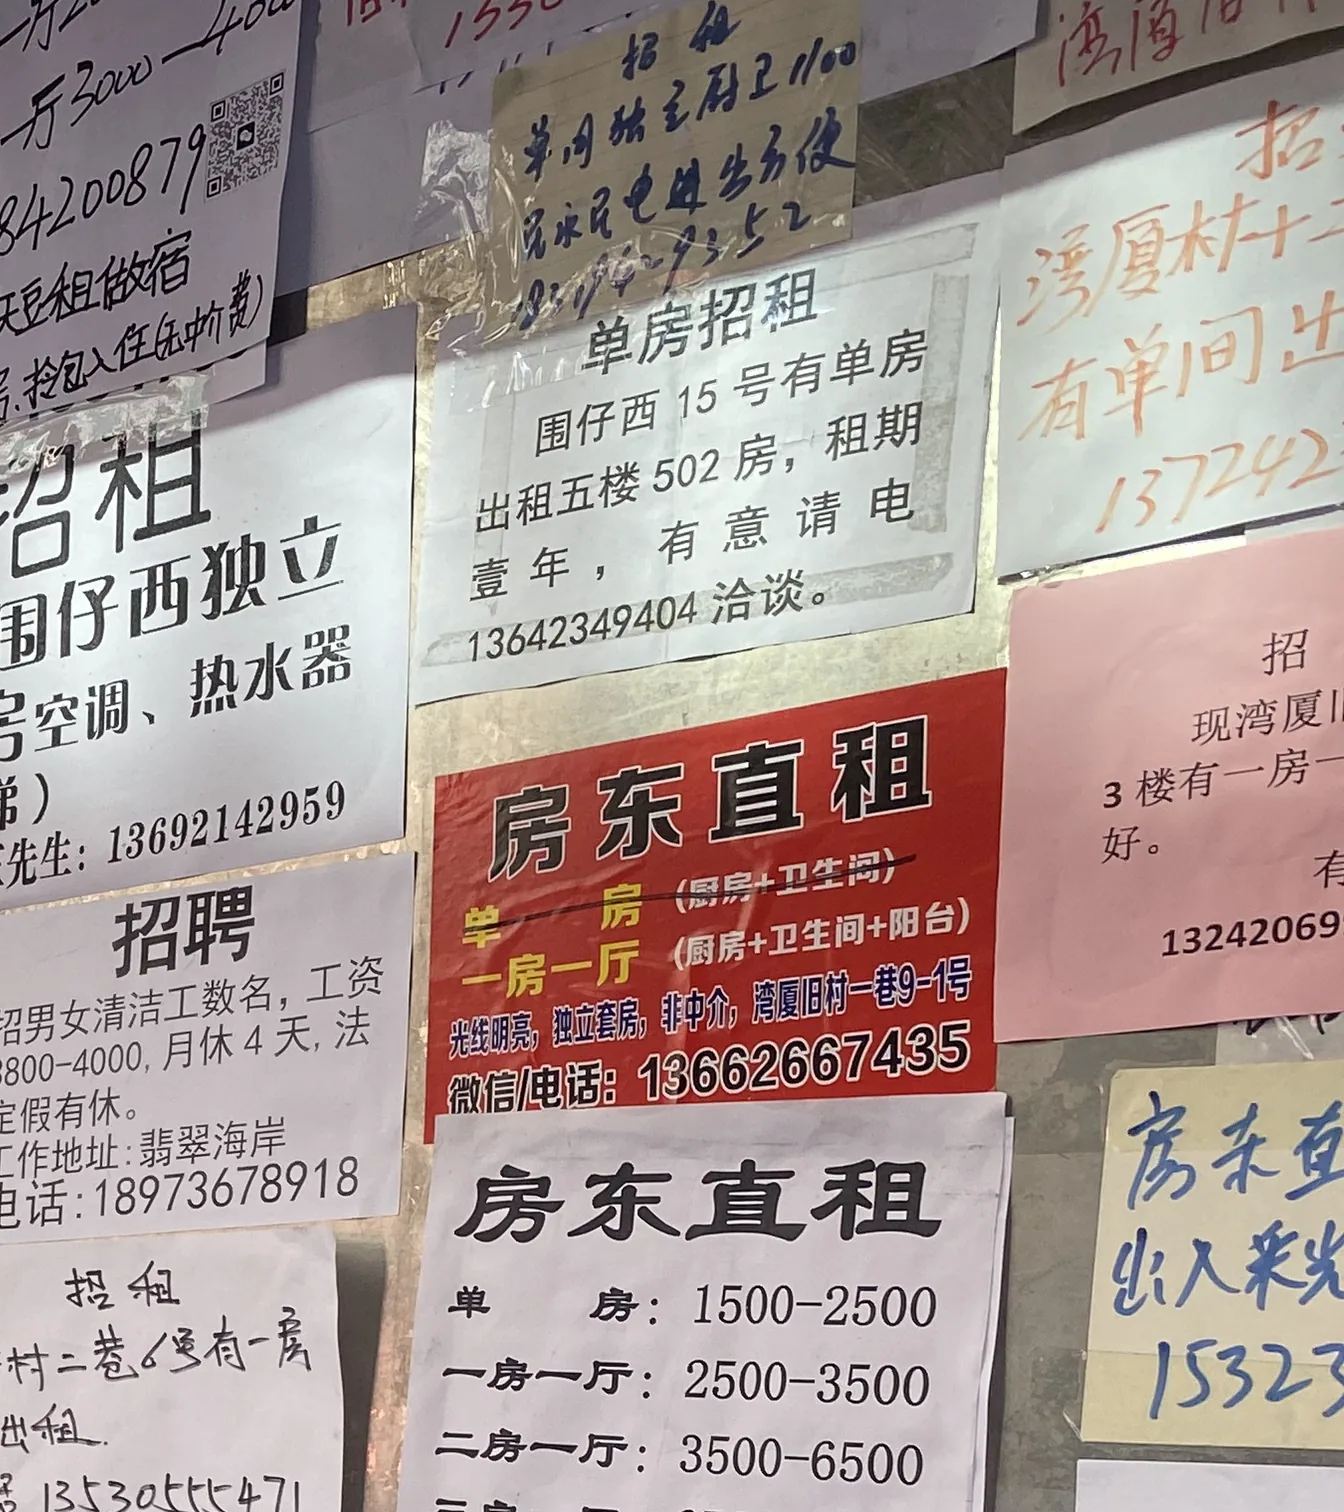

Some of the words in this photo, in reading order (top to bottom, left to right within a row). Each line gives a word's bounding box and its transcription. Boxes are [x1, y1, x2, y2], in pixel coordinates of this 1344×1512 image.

[1235, 99, 1344, 180] 招
[580, 267, 820, 376] 单房招租
[1191, 687, 1344, 745] 现湾厦
[487, 713, 932, 883] 房东直租
[112, 884, 256, 979] 招聘
[462, 939, 640, 998] 一房一厅
[1161, 910, 1344, 957] 13242069
[452, 1158, 943, 1244] 房东直租
[65, 1260, 180, 1309] 招租
